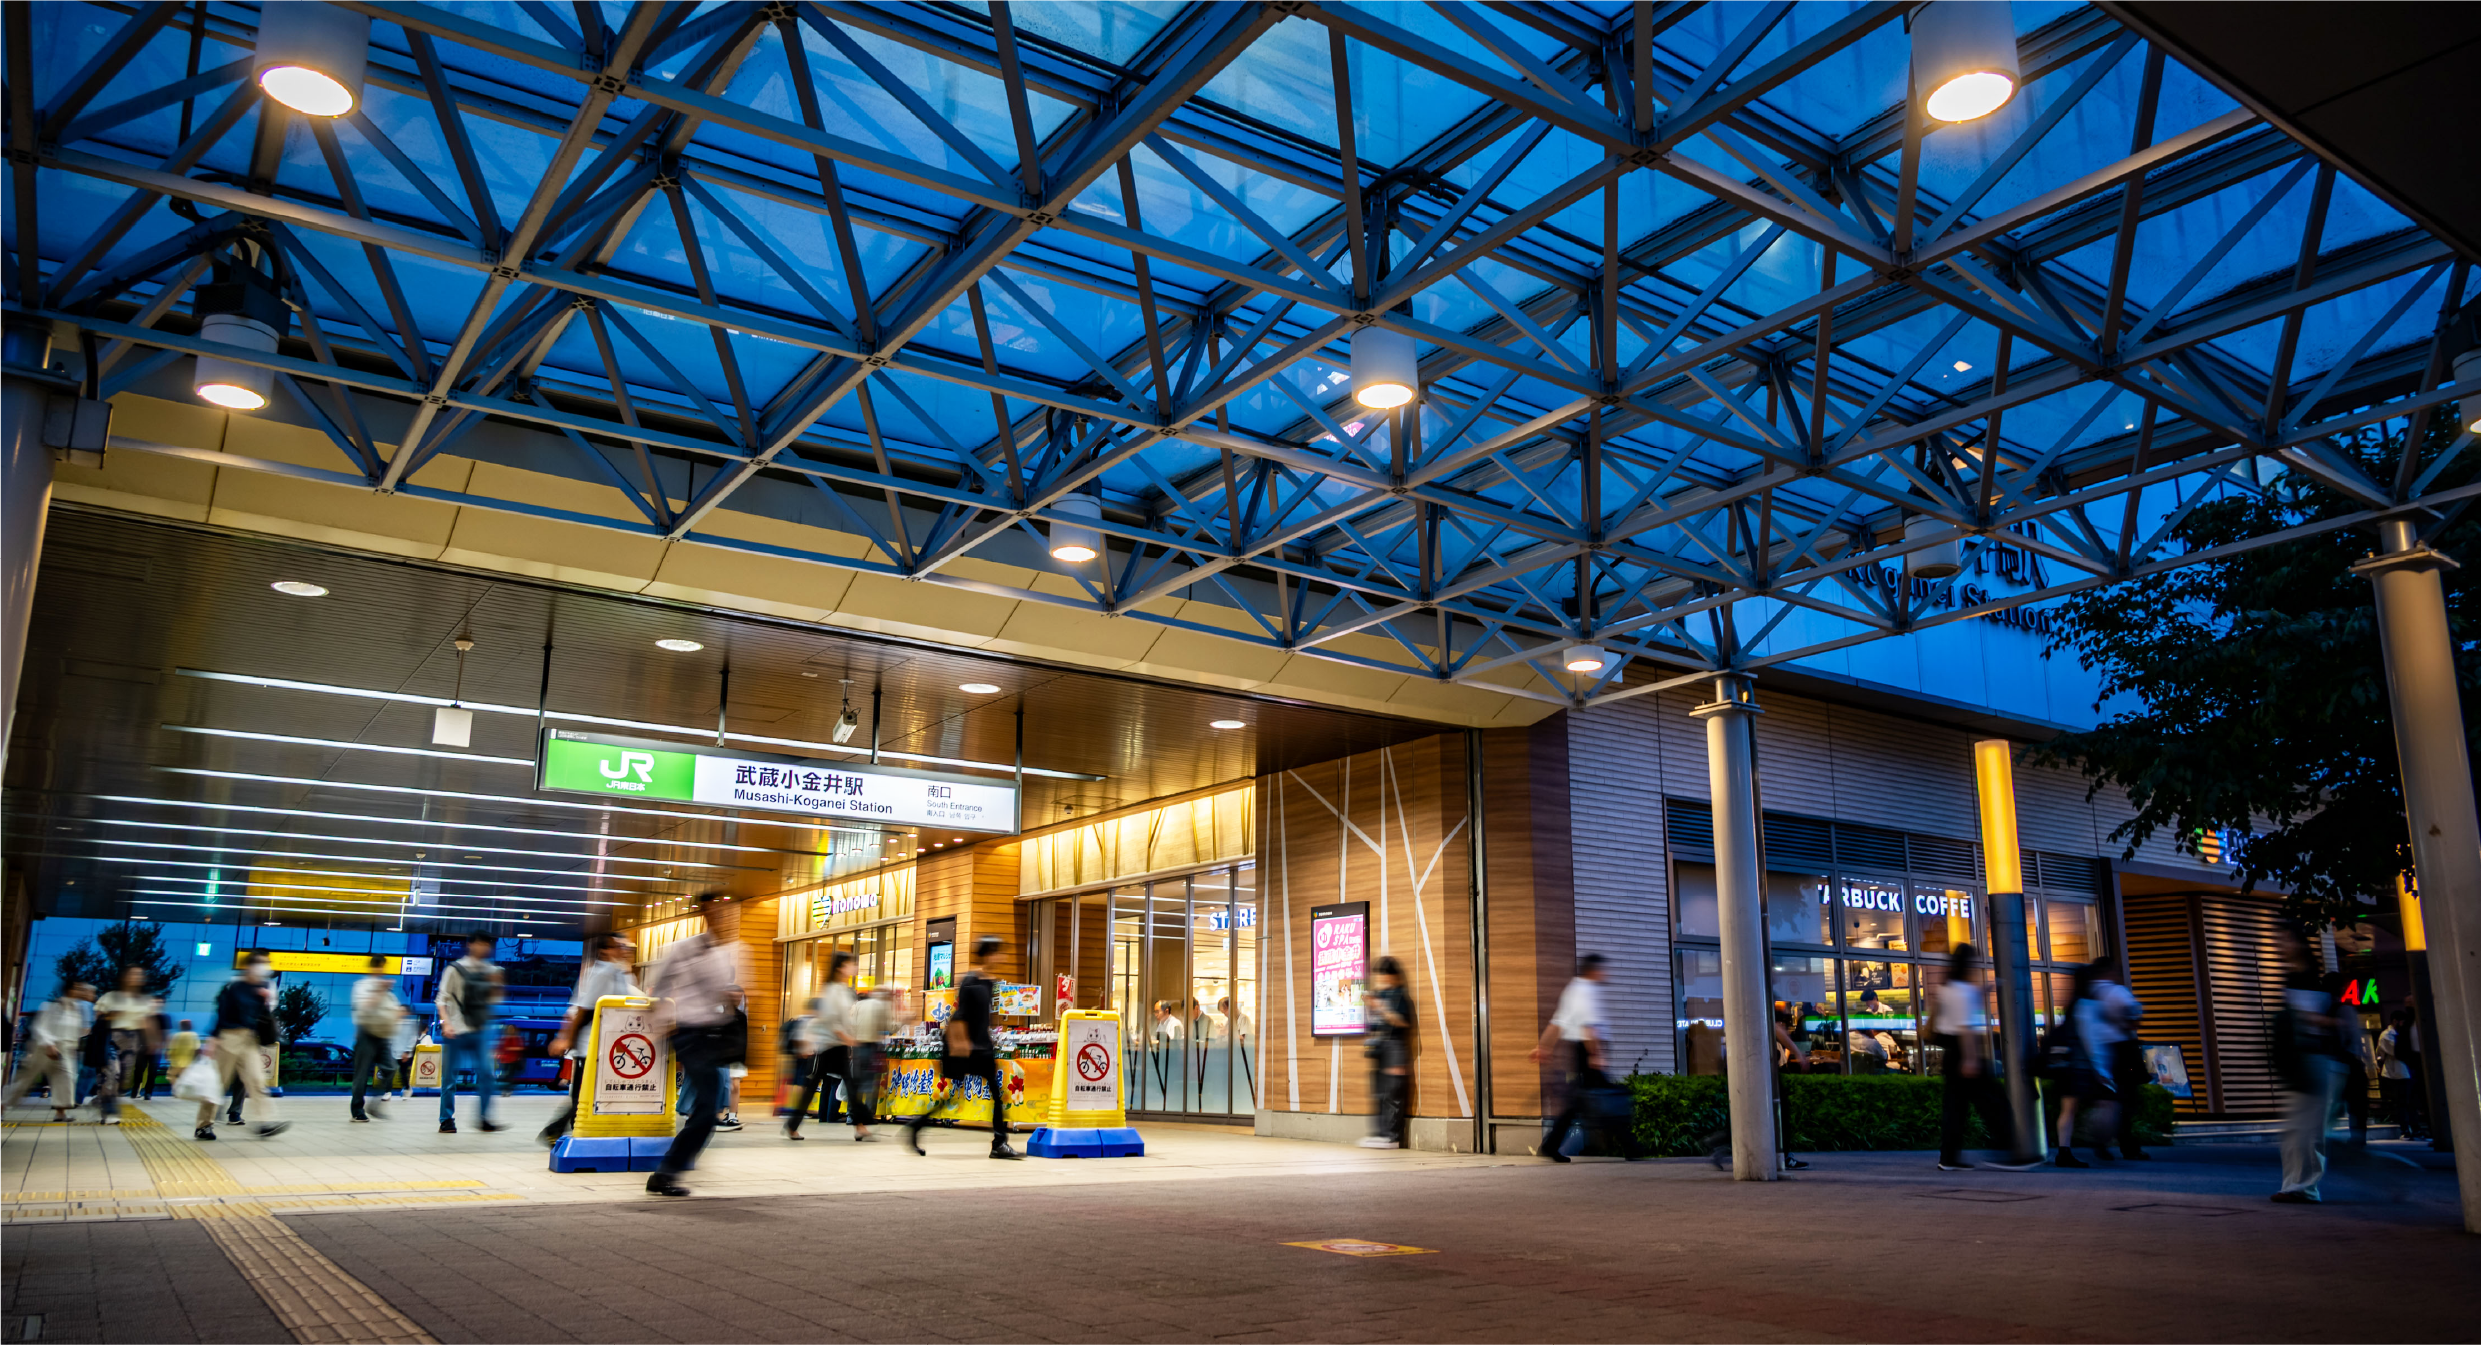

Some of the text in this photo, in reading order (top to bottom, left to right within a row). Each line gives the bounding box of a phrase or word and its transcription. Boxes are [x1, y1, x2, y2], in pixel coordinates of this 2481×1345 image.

[600, 751, 655, 783] JR
[606, 780, 646, 792] JR東日本
[735, 765, 864, 796] 武蔵小金井駅
[734, 788, 893, 814] Musashi-Koganei Station
[927, 785, 951, 799] 南口
[927, 800, 983, 812] South Entrance
[832, 893, 878, 915] nonowa
[1817, 884, 1904, 913] ARBUCK
[1333, 922, 1356, 935] RAKU
[605, 1083, 657, 1091] 自転車通行禁止
